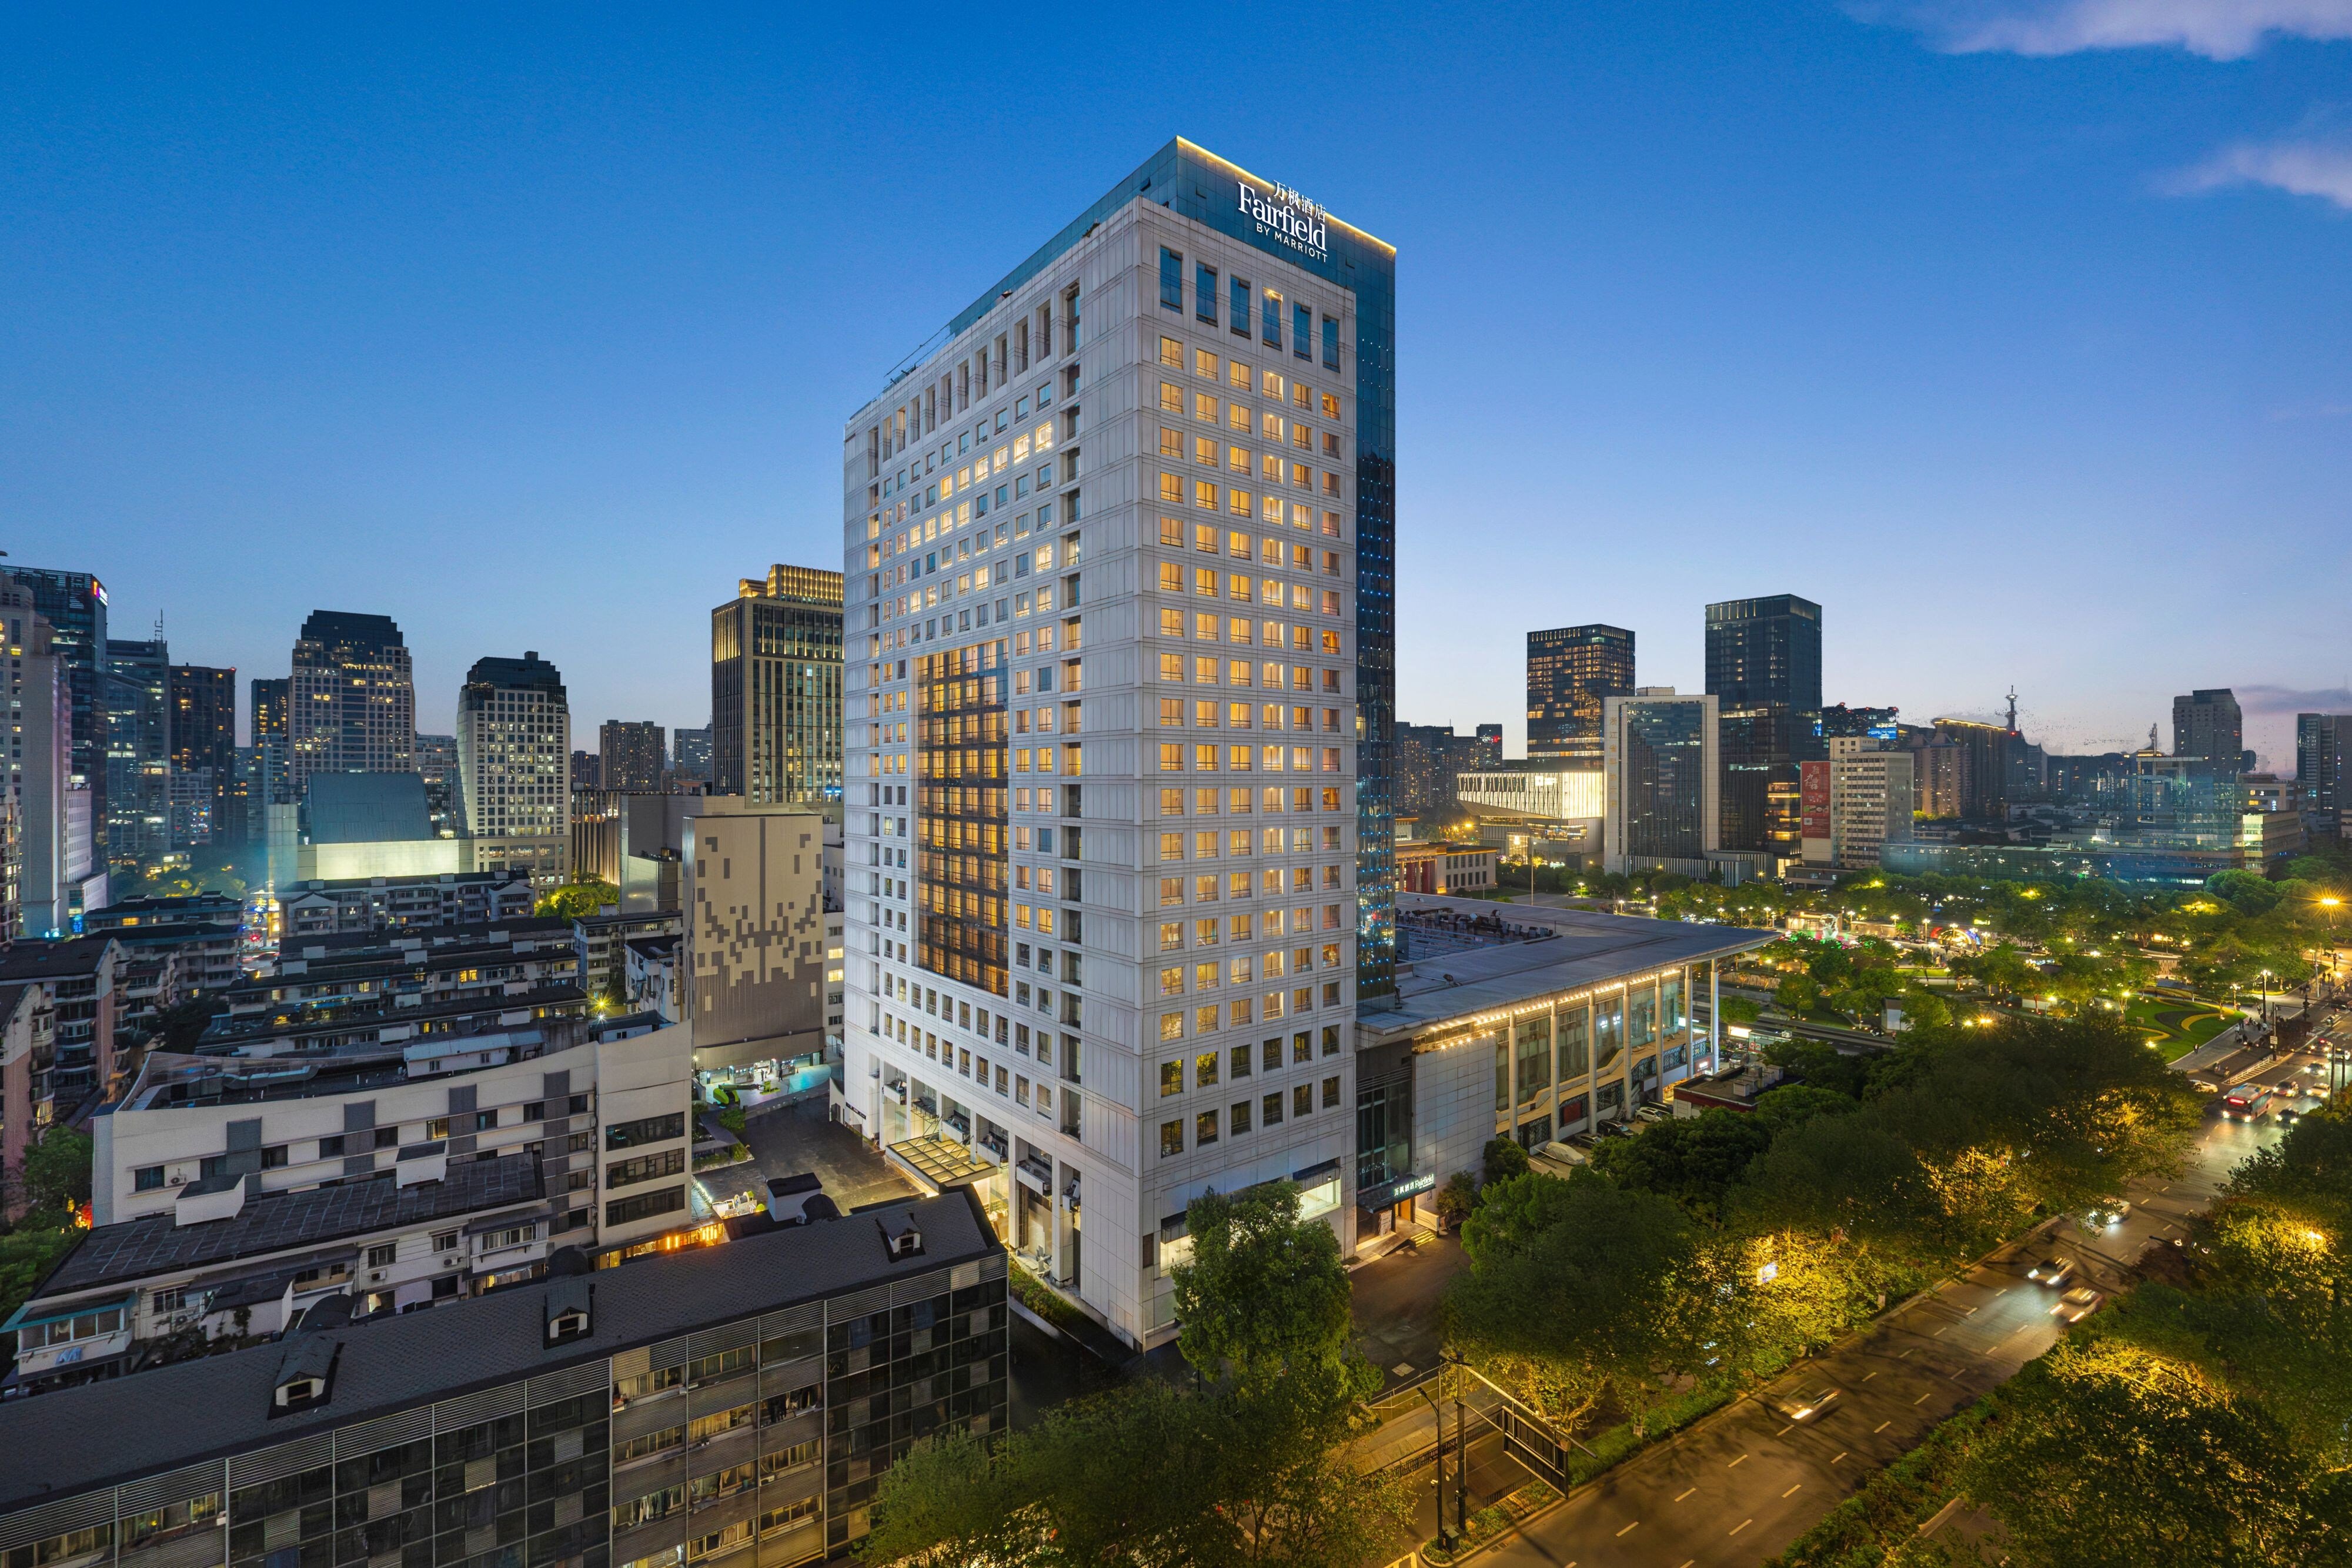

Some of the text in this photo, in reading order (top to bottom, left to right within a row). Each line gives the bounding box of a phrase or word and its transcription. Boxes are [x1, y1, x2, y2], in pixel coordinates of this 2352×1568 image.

[1238, 181, 1327, 252] Fairfield
[1273, 179, 1327, 223] 万枫酒店
[1257, 222, 1328, 263] BY MARRIOTT
